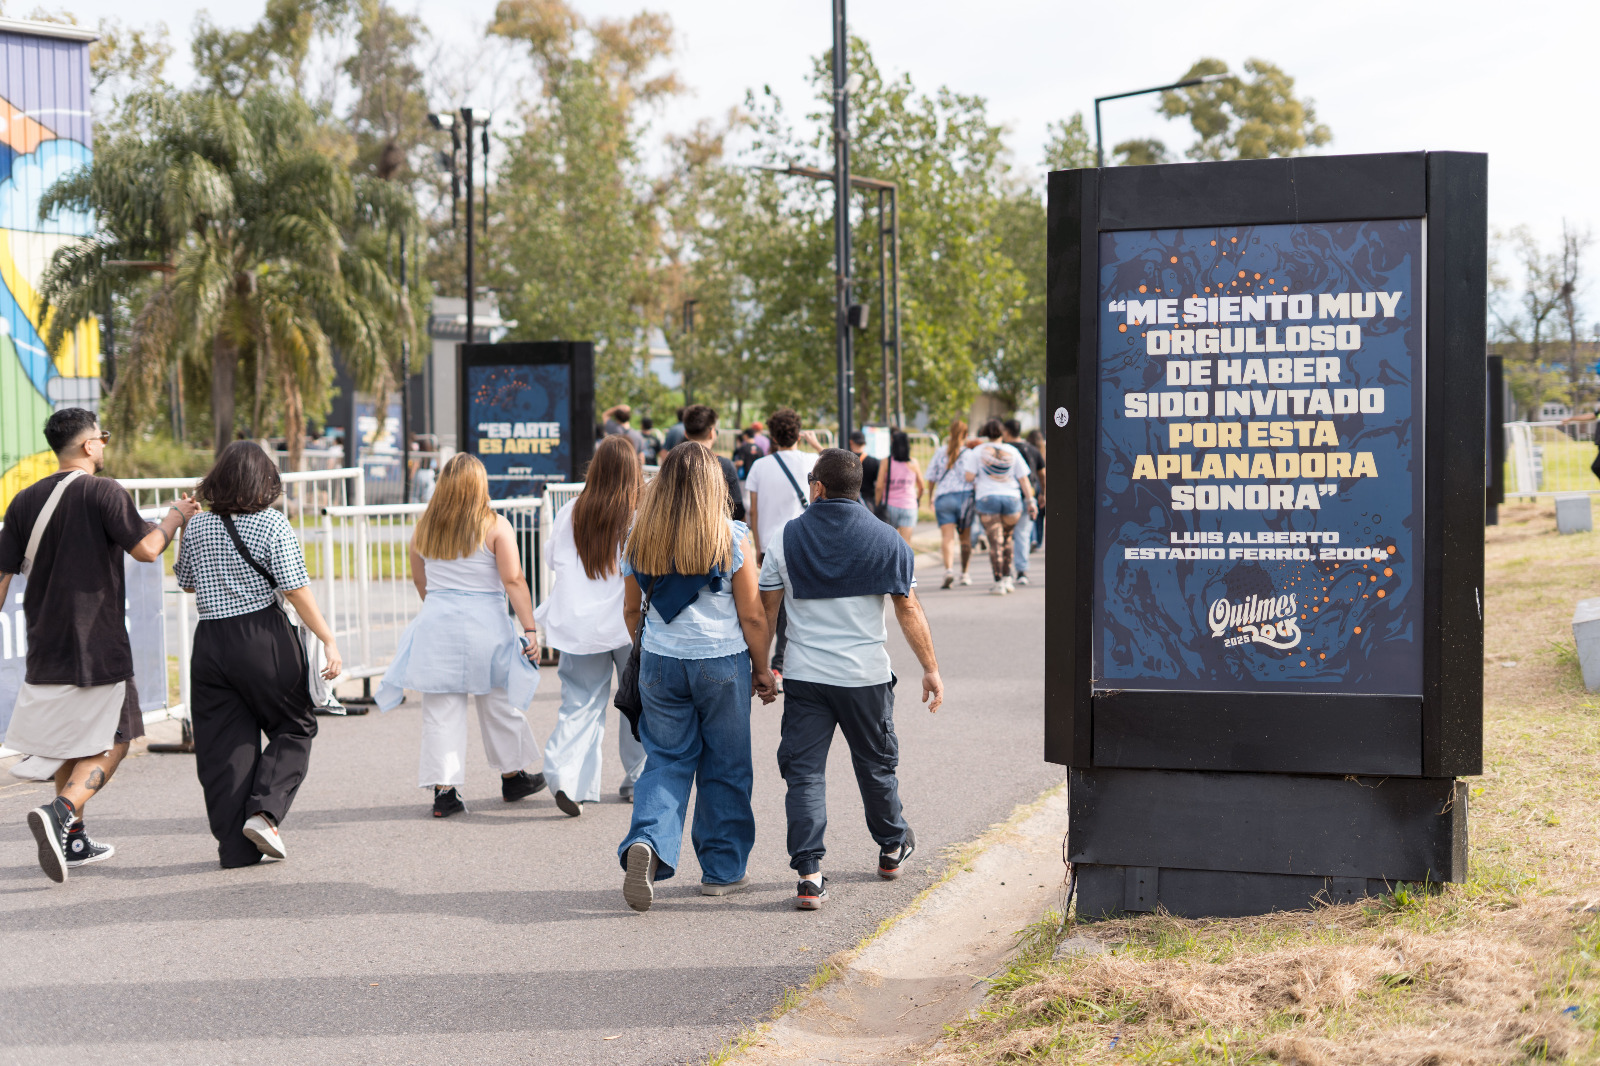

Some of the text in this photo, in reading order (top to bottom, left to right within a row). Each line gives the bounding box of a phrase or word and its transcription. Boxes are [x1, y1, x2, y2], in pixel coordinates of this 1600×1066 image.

[1108, 291, 1403, 325] “ME SIENTO MUY
[1146, 324, 1361, 355] ORGULLOSO
[1166, 356, 1341, 386] DE HABER
[1124, 387, 1385, 418] SIDO INVITADO
[513, 422, 560, 438] ARTE
[1168, 420, 1340, 448] POR ESTA
[479, 438, 503, 454] ES
[1131, 451, 1379, 480] APLANADORA
[1171, 484, 1338, 511] SONORA”
[1170, 531, 1340, 544] LUIS ALBERTO
[1124, 547, 1389, 561] ESTADIO FERRO, 2004
[1208, 593, 1296, 639] Quilmes
[1223, 634, 1251, 648] 2025
